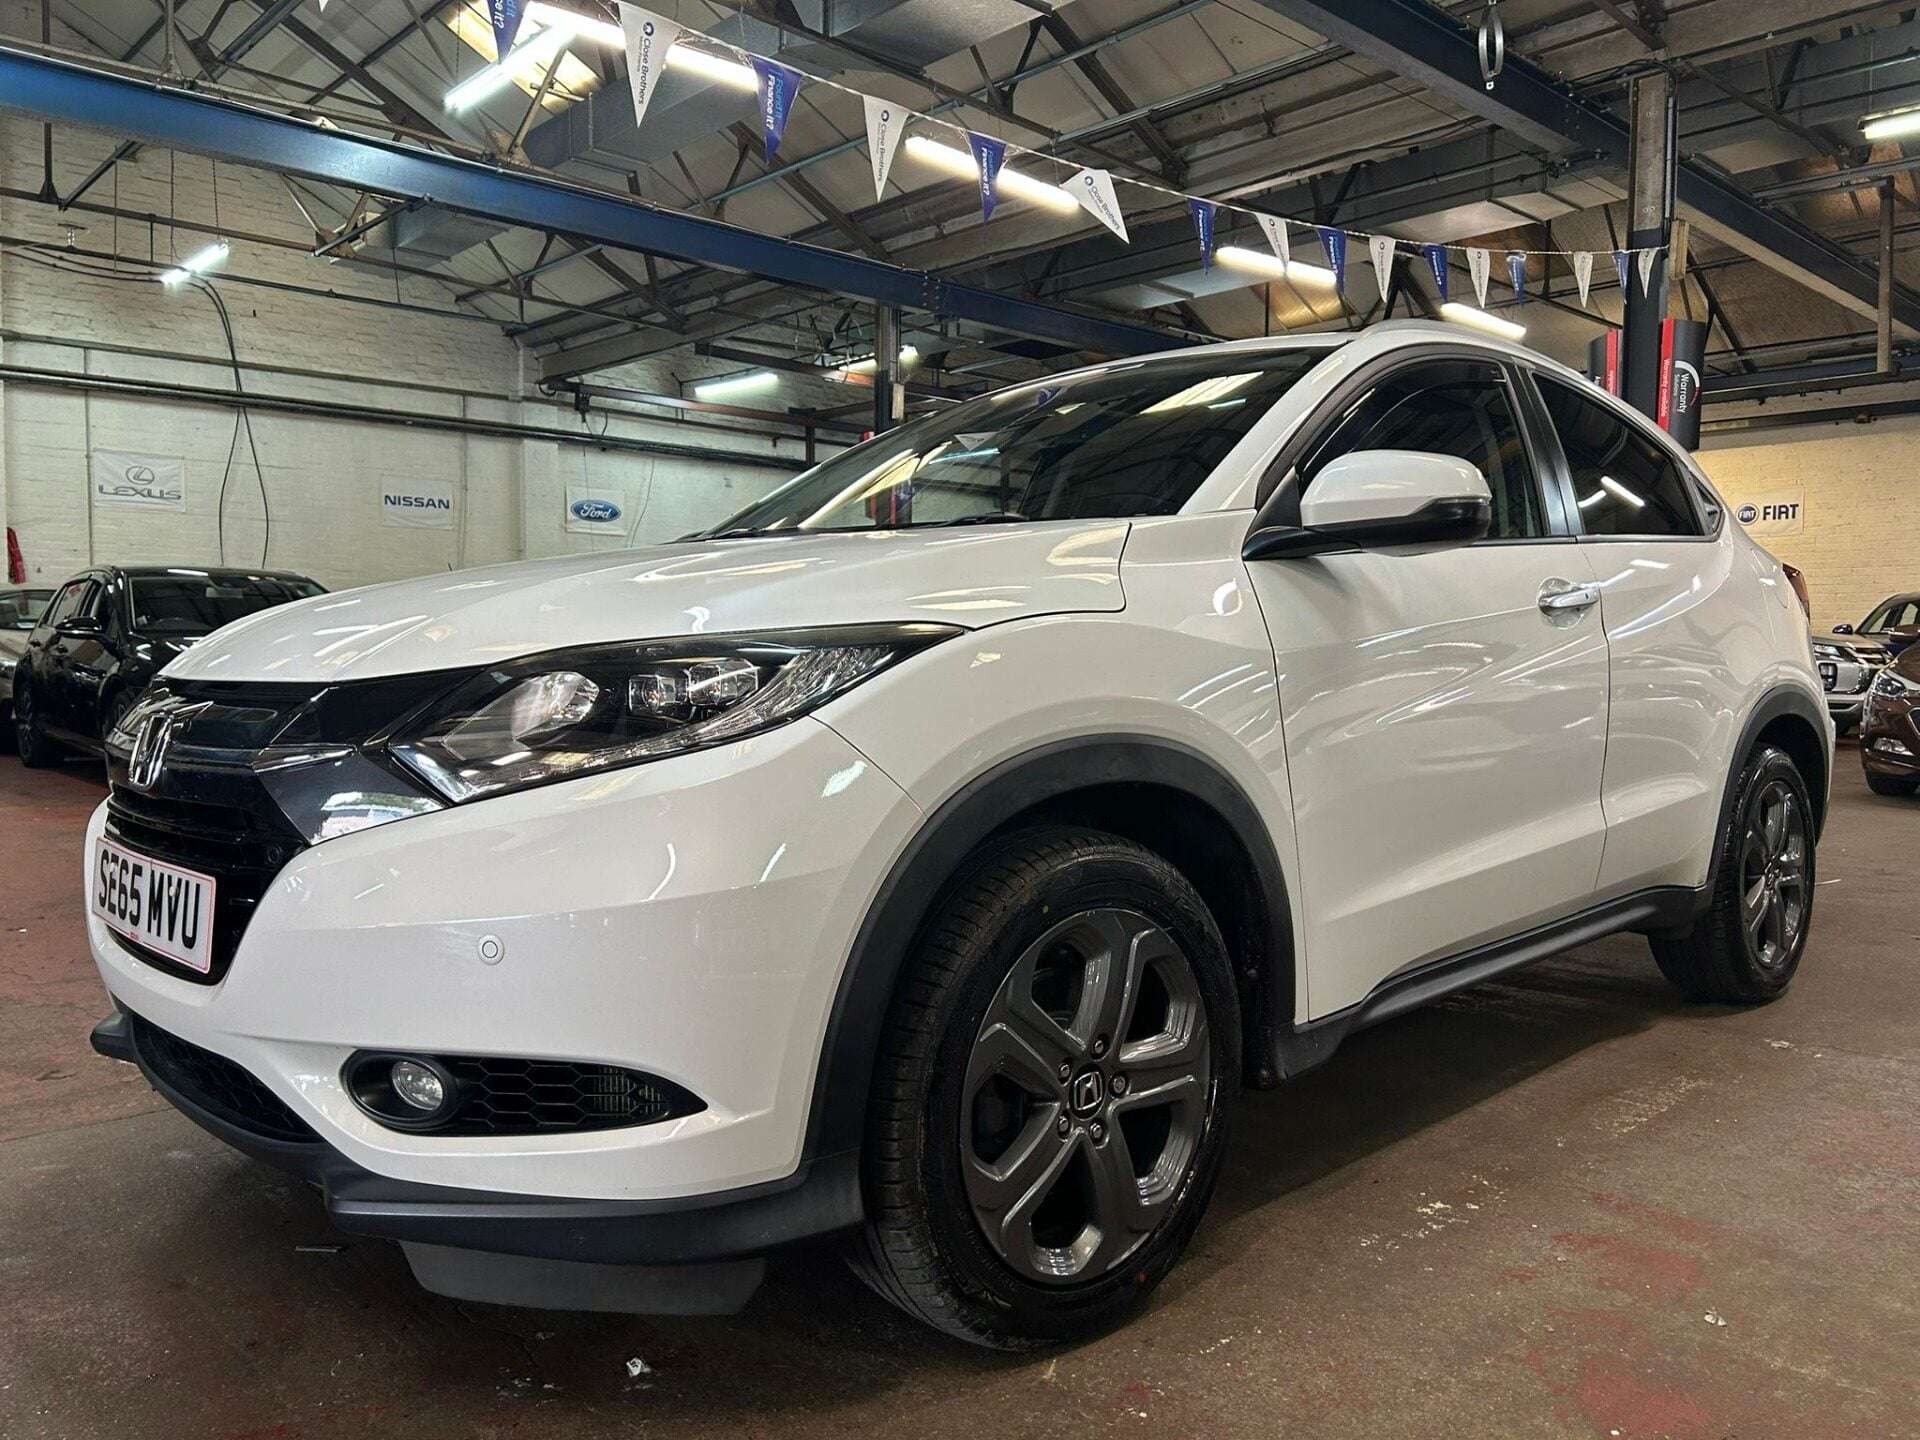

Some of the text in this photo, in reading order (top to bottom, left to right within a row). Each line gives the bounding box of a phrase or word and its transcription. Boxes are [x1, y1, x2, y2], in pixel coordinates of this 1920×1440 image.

[638, 38, 651, 105] Close Brothers
[766, 74, 776, 130] Finance it?
[1661, 359, 1671, 388] Warranty
[1676, 373, 1690, 413] Warranty
[98, 484, 182, 500] LEXUS
[384, 494, 450, 510] NISSAN
[580, 503, 612, 519] Ford
[1763, 503, 1800, 521] FIAT
[99, 848, 201, 950] SE65 MVU
